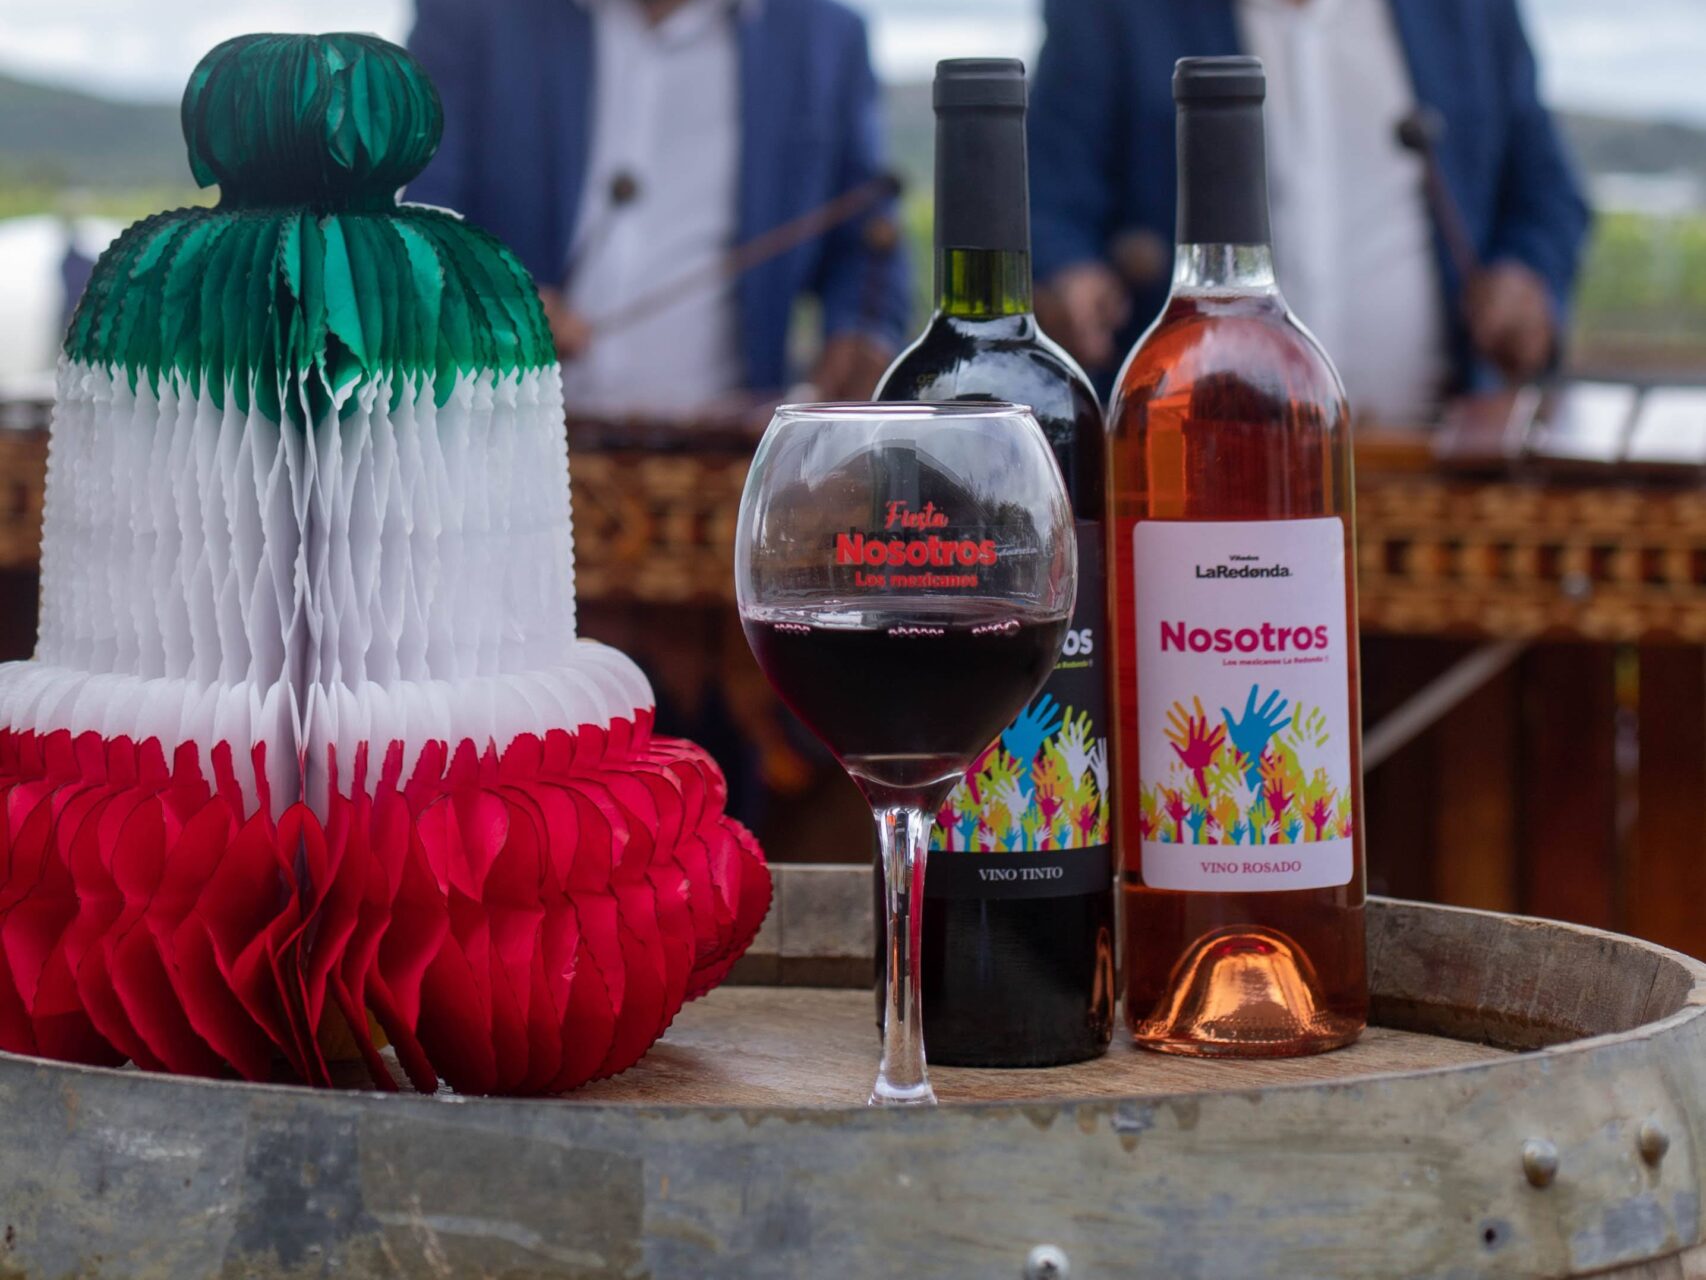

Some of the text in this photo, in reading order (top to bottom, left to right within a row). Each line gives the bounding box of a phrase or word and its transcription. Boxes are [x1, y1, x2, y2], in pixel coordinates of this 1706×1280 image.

[884, 500, 949, 532] Fiesta
[836, 532, 998, 567] Nosotros
[856, 572, 978, 588] Los mexicanos
[1160, 621, 1328, 652] Nosotros
[979, 867, 1064, 881] VINO TINTO
[1200, 860, 1302, 874] VINO ROSADO
